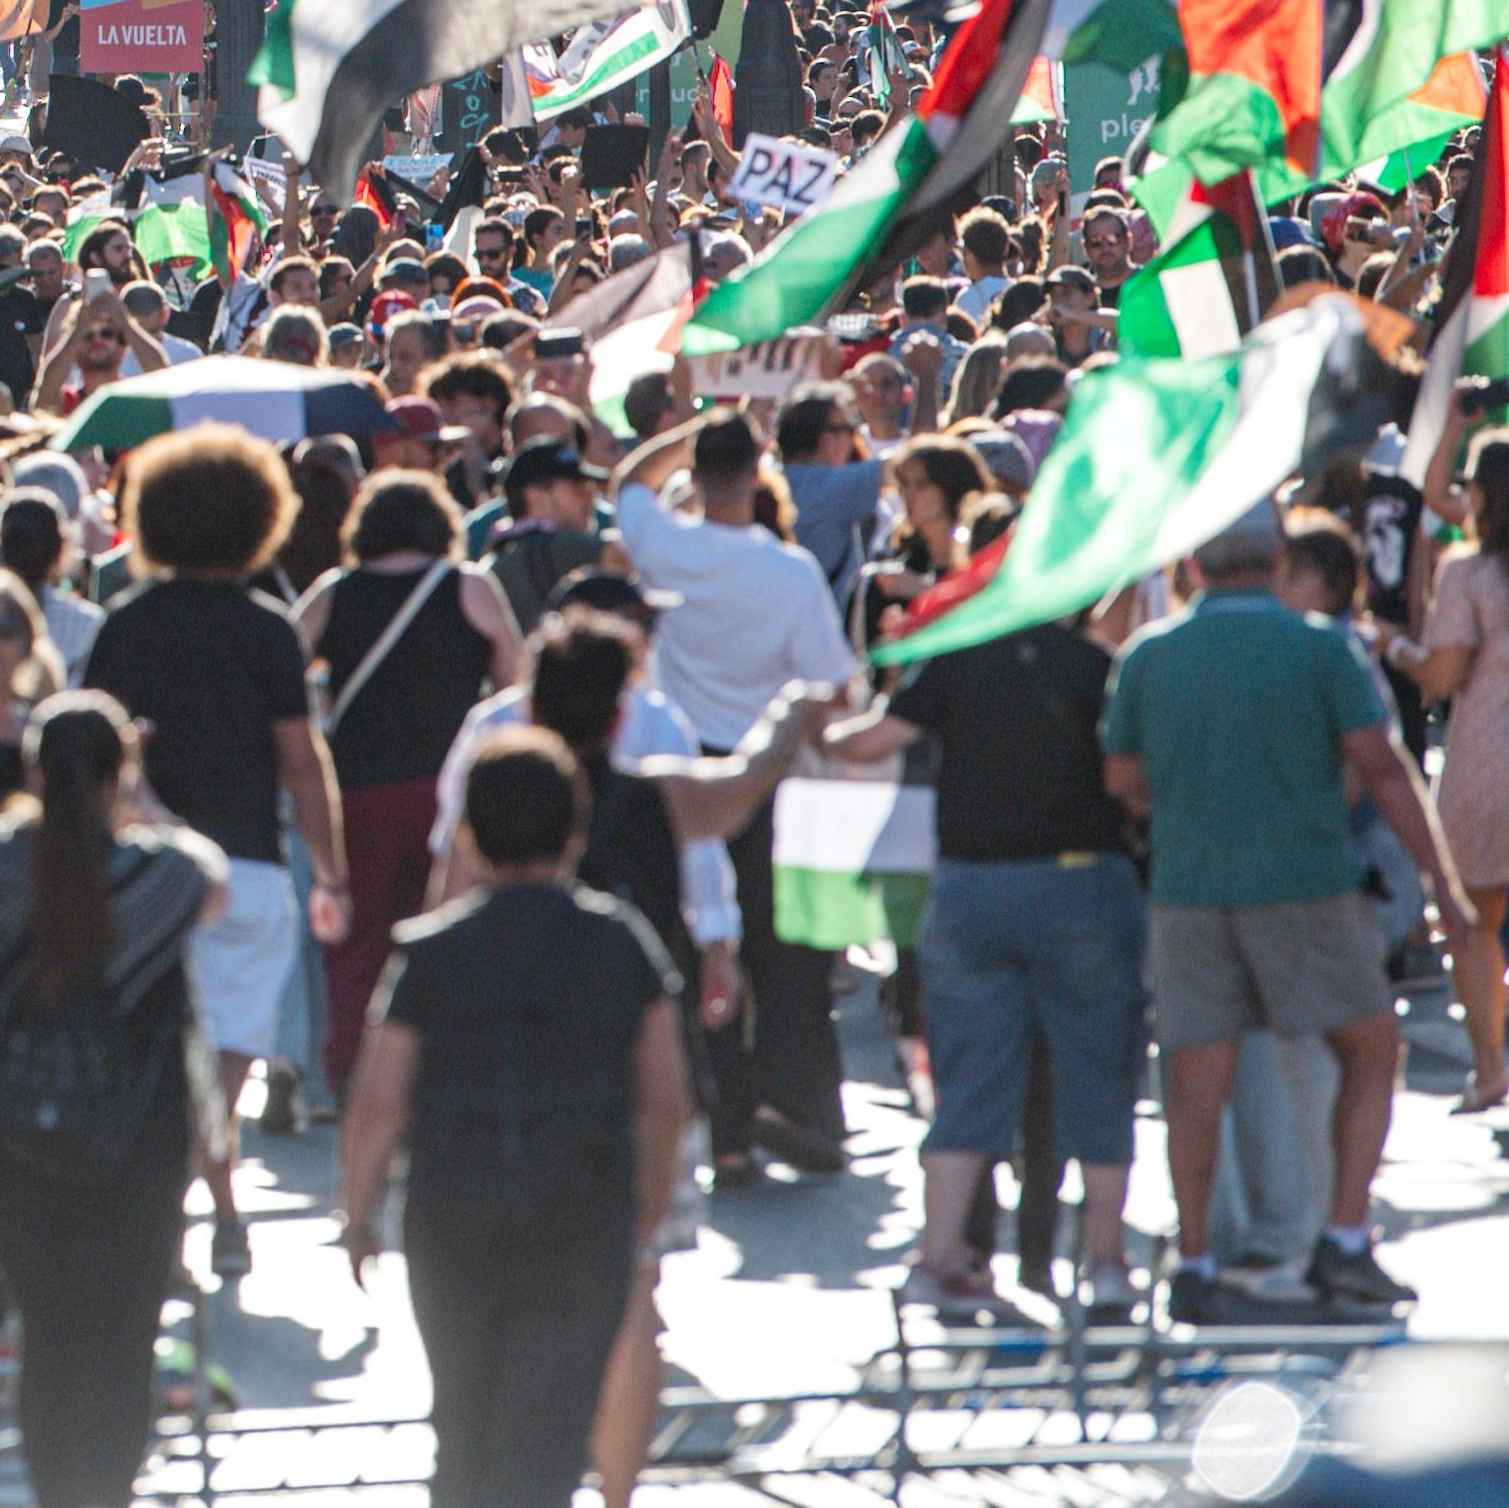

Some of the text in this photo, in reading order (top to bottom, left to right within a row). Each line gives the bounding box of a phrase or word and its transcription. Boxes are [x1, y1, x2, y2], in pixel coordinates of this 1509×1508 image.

[98, 25, 187, 45] LA VUELTA
[739, 147, 828, 205] PAZ
